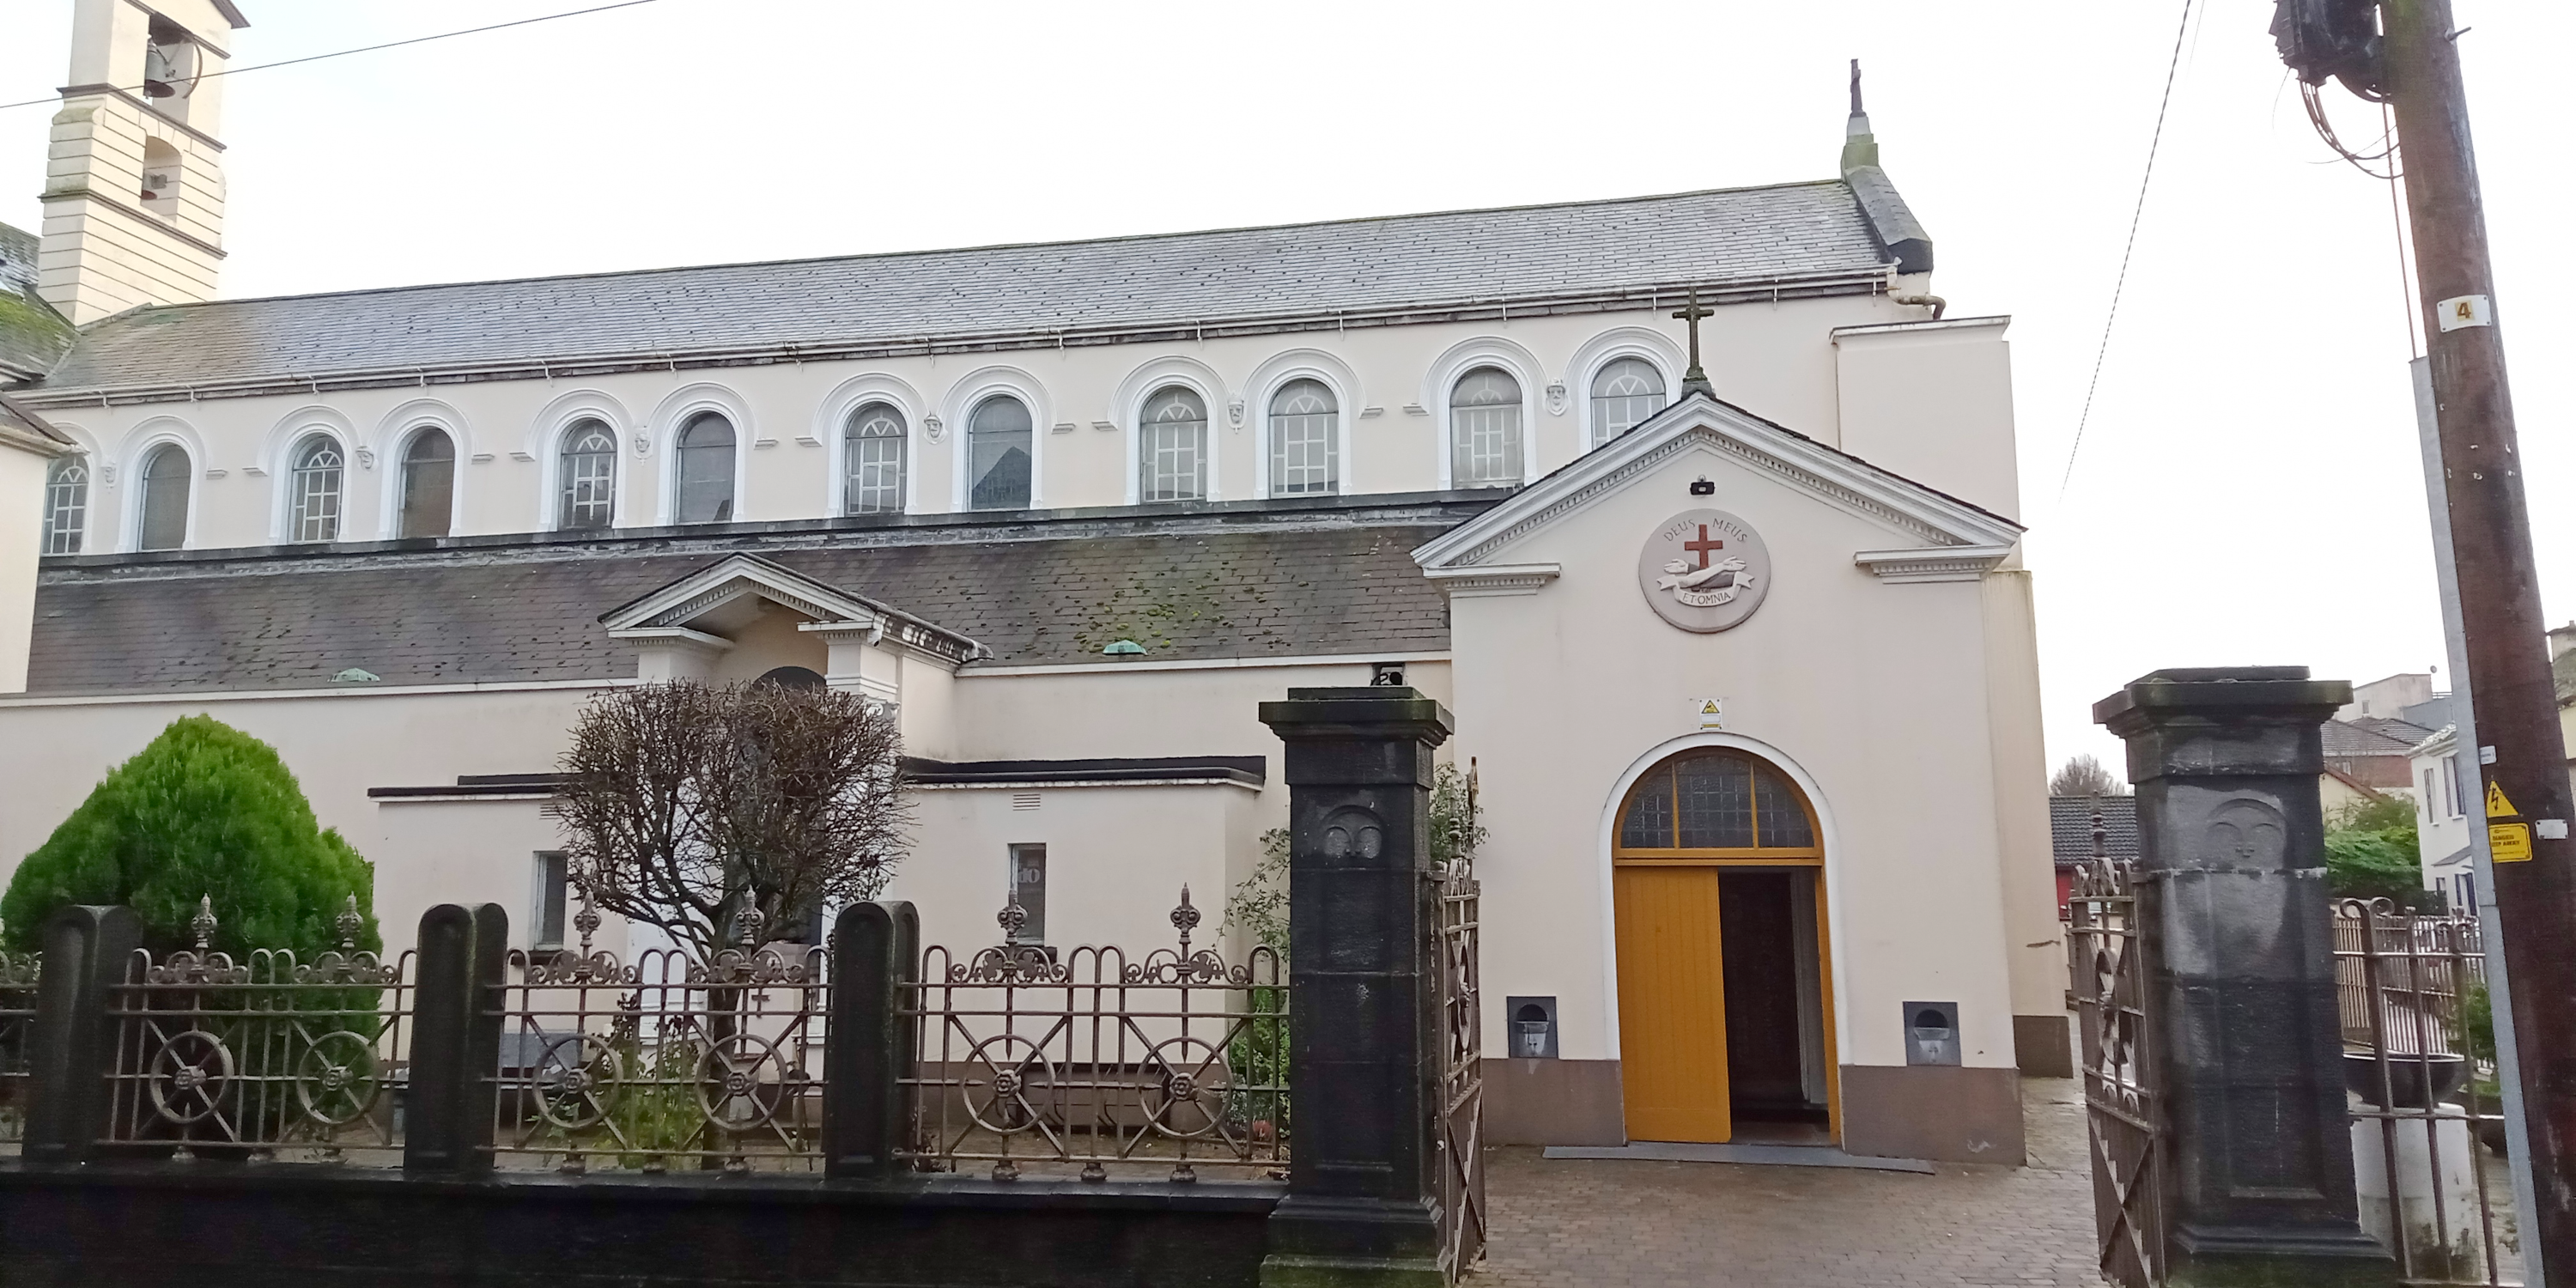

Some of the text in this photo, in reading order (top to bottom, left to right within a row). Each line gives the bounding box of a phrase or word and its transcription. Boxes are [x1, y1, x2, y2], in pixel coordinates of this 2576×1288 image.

[2458, 302, 2471, 319] 4
[1663, 518, 1748, 543] DEUS MEUS
